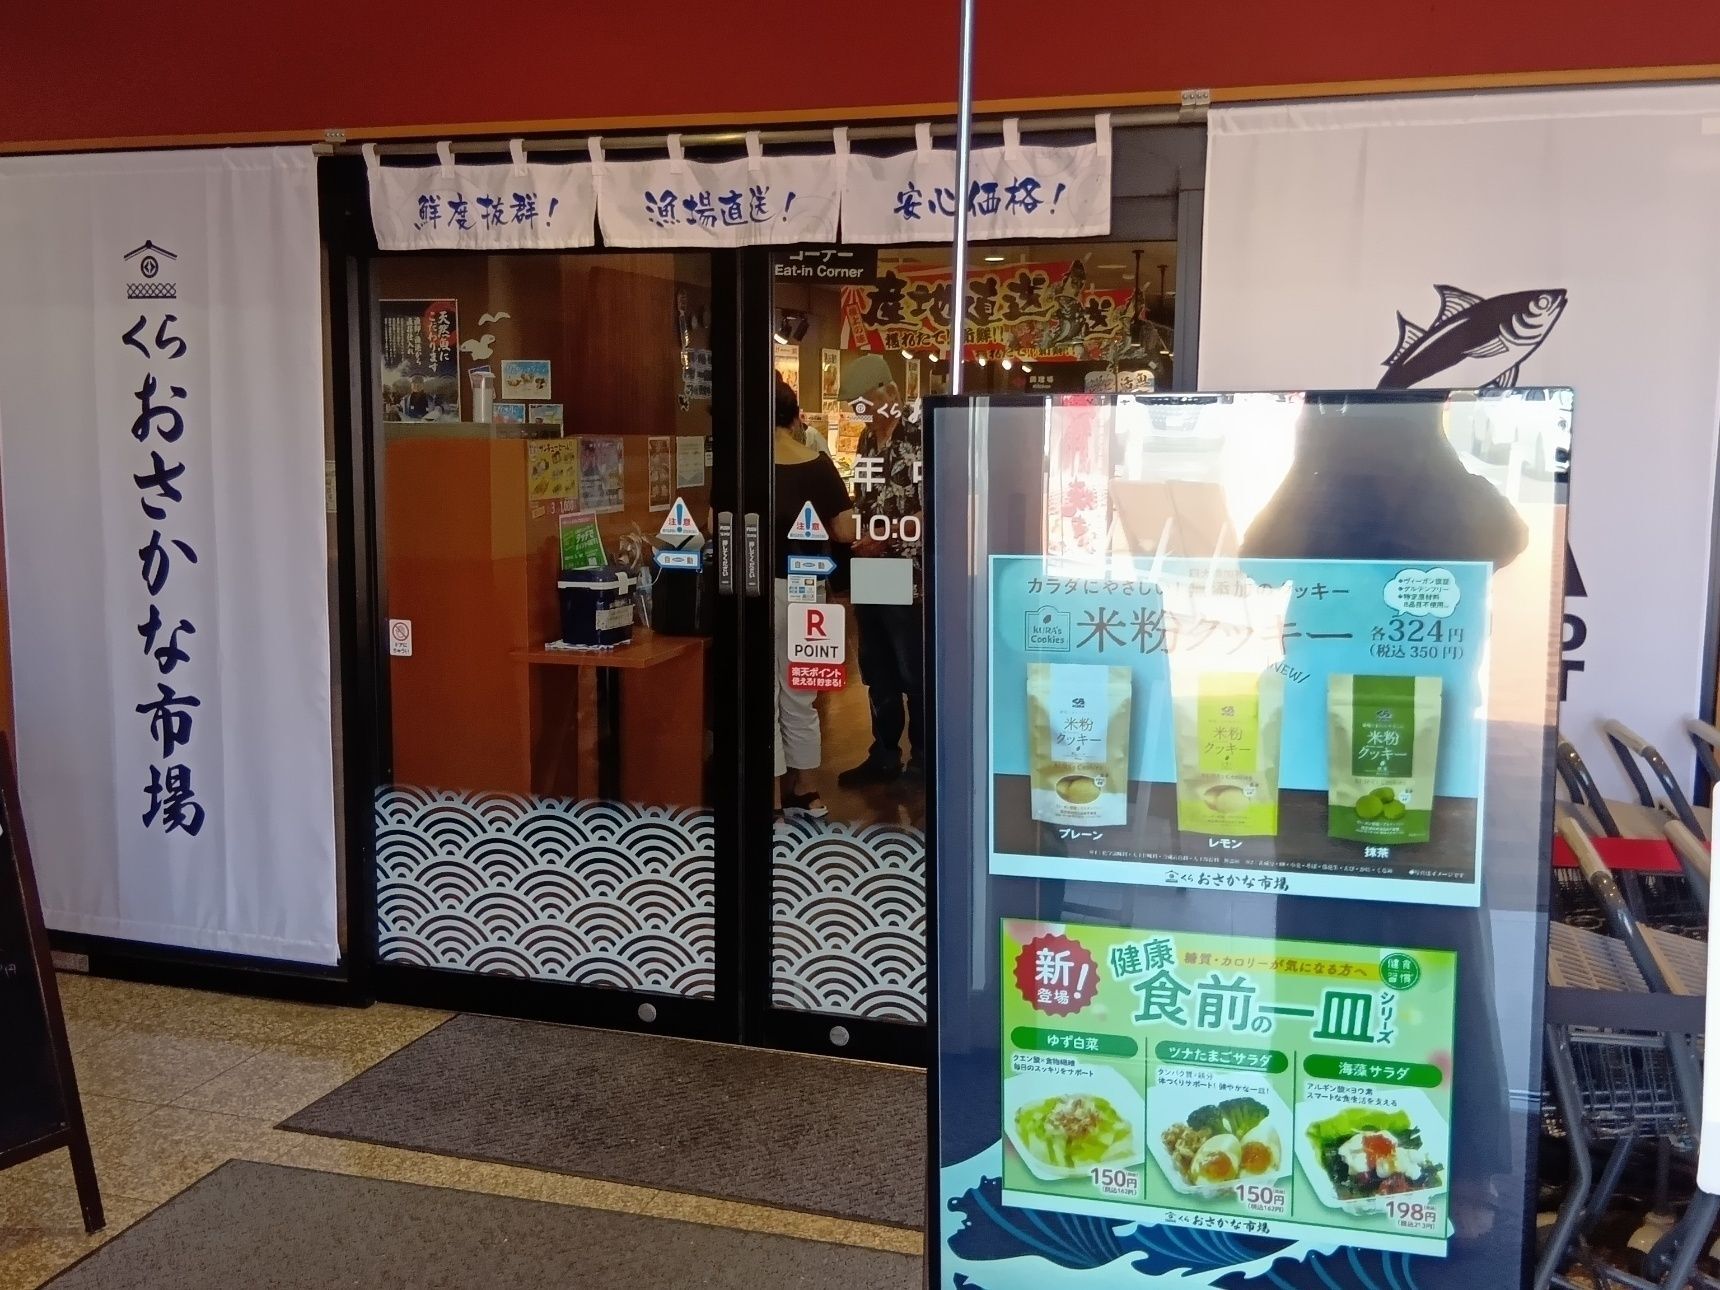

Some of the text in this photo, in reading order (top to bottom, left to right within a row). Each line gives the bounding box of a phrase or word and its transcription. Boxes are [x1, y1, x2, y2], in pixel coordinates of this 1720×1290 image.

[645, 185, 796, 228] 漁場直送!
[894, 177, 1066, 219] 安心価格!
[414, 192, 559, 231] 鮮度抜群!
[775, 265, 863, 279] Eat-in Corner
[1030, 634, 1065, 644] Cookies
[795, 644, 838, 659] POINT
[1064, 717, 1094, 732] 米粉
[1056, 733, 1102, 746] クッキー
[1367, 730, 1399, 746] 米粉
[1204, 742, 1251, 755] クッキー
[1358, 747, 1407, 761] クッキー
[1058, 828, 1104, 842] プレーン
[1208, 837, 1244, 850] レモン
[1364, 846, 1390, 859] 抹茶
[1110, 939, 1175, 979] 健康
[1037, 988, 1069, 1005] 登場
[1133, 969, 1374, 1043] 食前の一皿
[1377, 991, 1395, 1044] シリーズ
[1047, 1034, 1099, 1051] ゆず白菜
[1169, 1046, 1272, 1067] ツナたまごサラダ
[1338, 1061, 1410, 1081] 海藻サラダ
[1091, 1167, 1138, 1189] 150円
[1236, 1184, 1285, 1206] 150円
[1385, 1200, 1436, 1223] 198円
